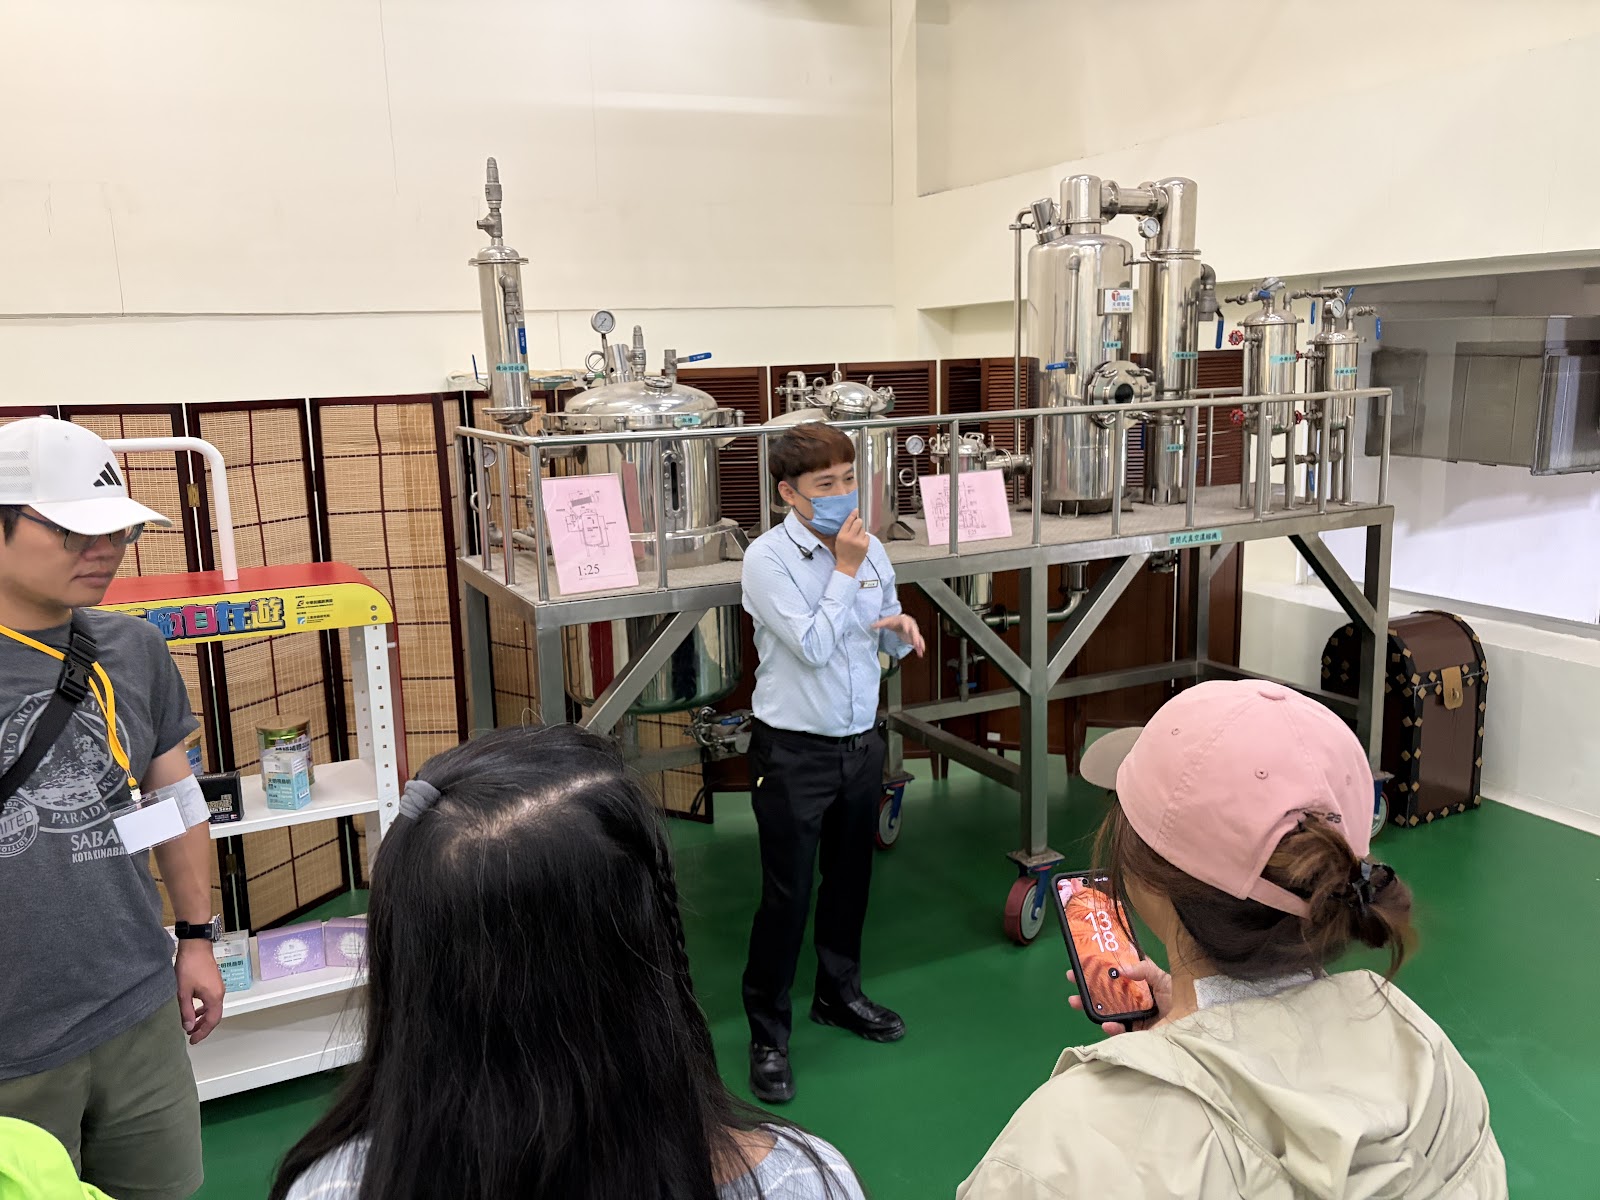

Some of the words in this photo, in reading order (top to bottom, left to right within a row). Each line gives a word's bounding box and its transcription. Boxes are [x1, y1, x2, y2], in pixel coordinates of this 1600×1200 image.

[577, 563, 600, 576] 1:25
[70, 828, 124, 852] SABA
[1085, 910, 1112, 932] 13
[1091, 931, 1119, 953] 18
